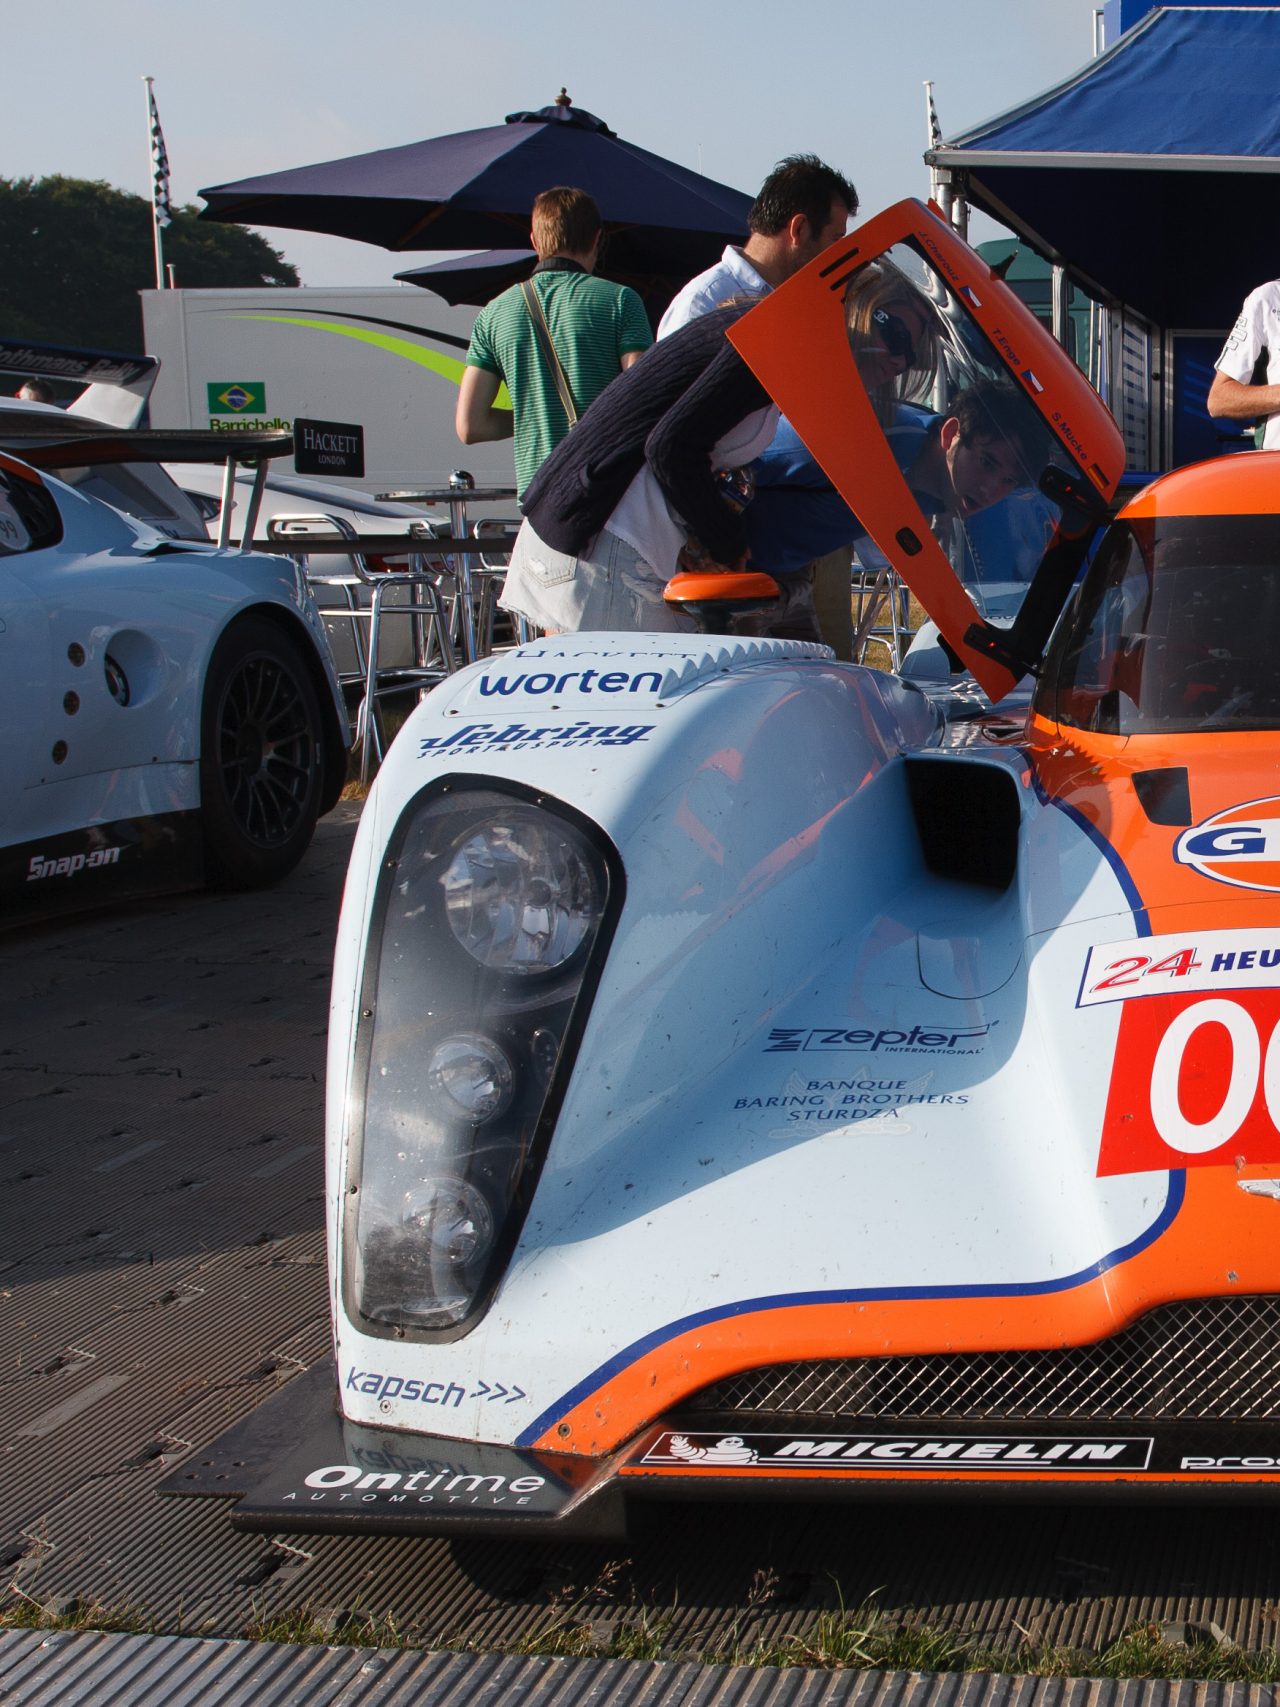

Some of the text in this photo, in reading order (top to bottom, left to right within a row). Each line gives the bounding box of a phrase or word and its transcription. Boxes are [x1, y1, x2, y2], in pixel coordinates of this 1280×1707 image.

[0, 345, 89, 373] othmans
[992, 327, 1021, 367] T.Enge
[210, 418, 291, 431] Barrichello
[303, 428, 358, 454] HACKETT
[318, 455, 347, 465] LONDON
[479, 669, 663, 697] worten
[420, 721, 657, 750] Sebring
[25, 847, 121, 882] Snap-on
[1090, 947, 1202, 994] 24
[817, 1024, 988, 1051] zepter
[884, 1046, 983, 1055] INTERNATIONAL
[806, 1080, 908, 1091] BANQUE
[733, 1093, 969, 1109] BARING BROTHERS
[786, 1108, 900, 1121] STURDZA
[346, 1366, 466, 1408] kapsch
[773, 1441, 1127, 1460] MICHELIN
[304, 1465, 546, 1494] Ontime
[282, 1492, 532, 1505] AUTOMOTIVE
